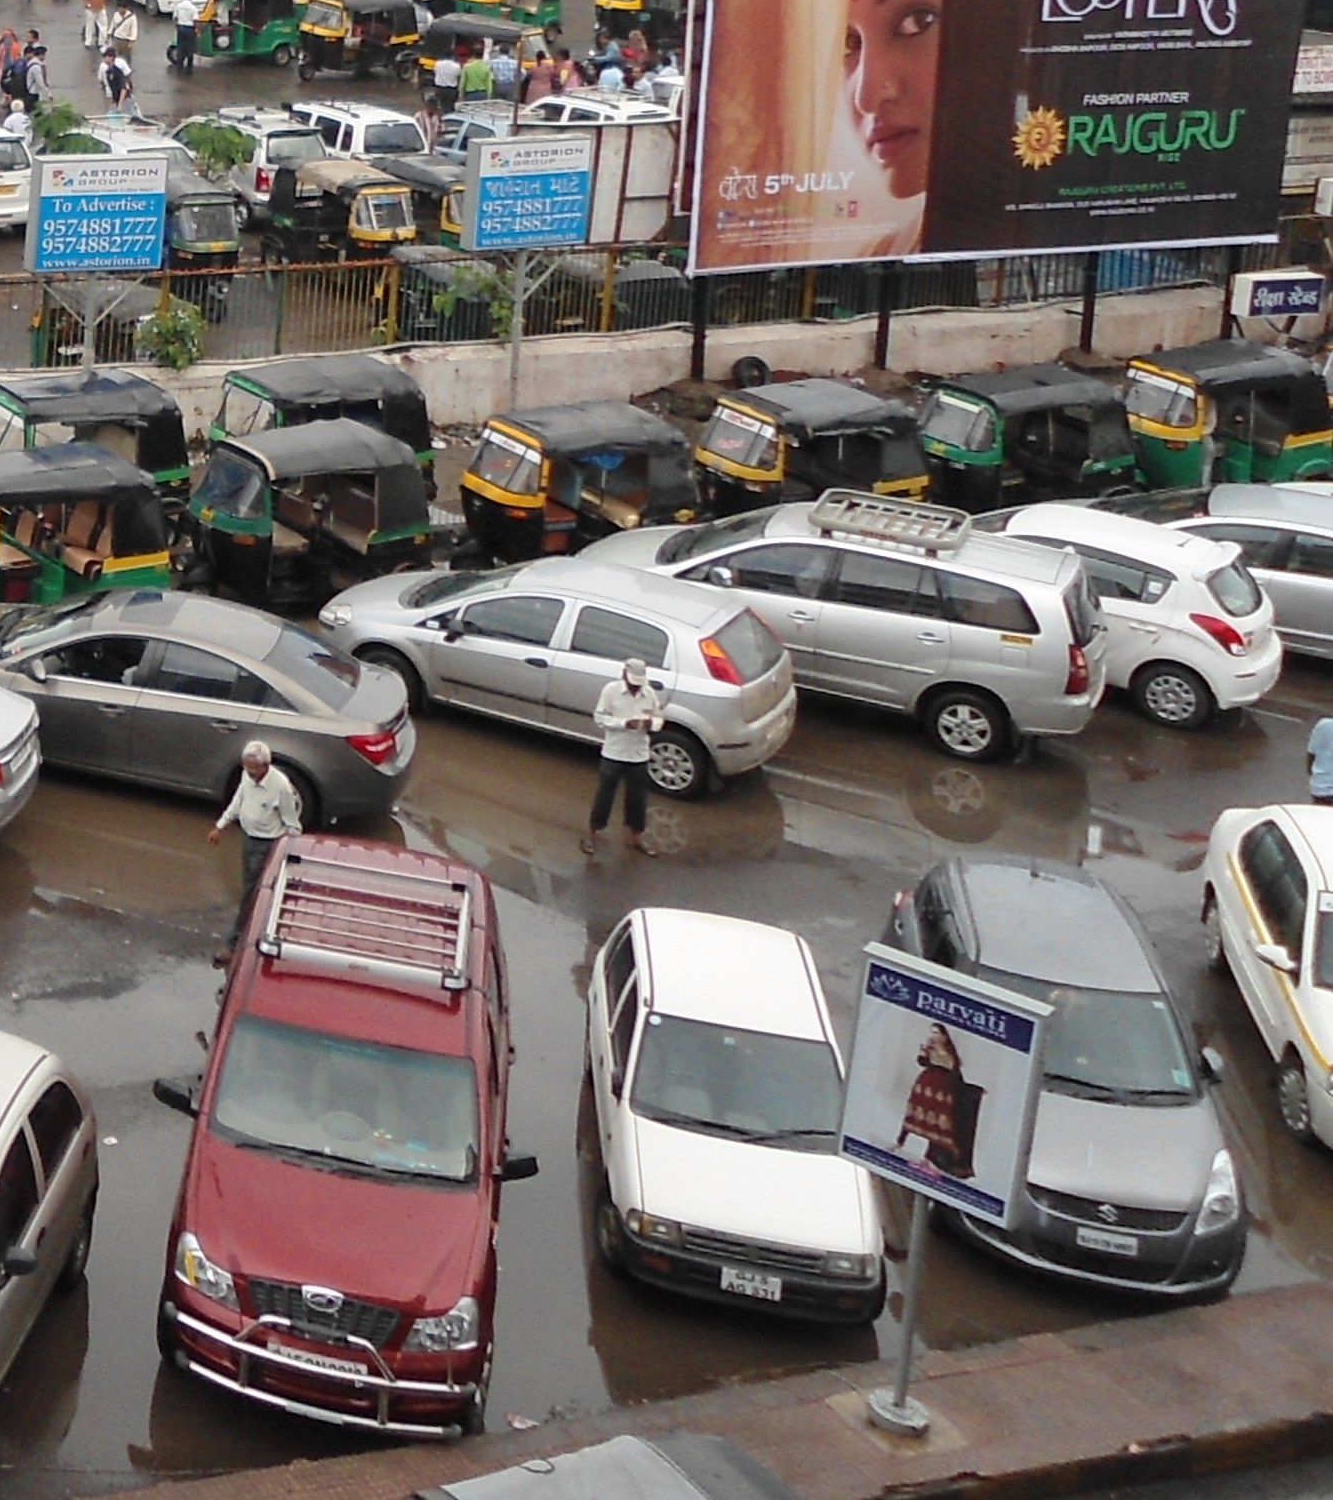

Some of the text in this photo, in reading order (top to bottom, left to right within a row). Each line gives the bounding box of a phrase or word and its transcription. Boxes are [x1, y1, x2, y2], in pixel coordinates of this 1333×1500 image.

[1083, 91, 1190, 106] FASHION PARTNER
[1067, 109, 1239, 157] RAJGURU
[514, 147, 583, 159] ASTORION
[513, 158, 556, 167] GROUP
[78, 178, 127, 186] GROUP
[79, 169, 159, 178] ASTORION
[763, 171, 855, 195] 5th JULY
[53, 199, 72, 213] To
[77, 197, 147, 212] Advertise
[482, 195, 583, 216] 9574881777
[43, 217, 158, 237] 9574881777
[481, 212, 582, 234] 9574882777
[42, 235, 156, 256] 9574882777
[42, 255, 150, 269] www.astorion.in
[916, 990, 1006, 1035] parvati
